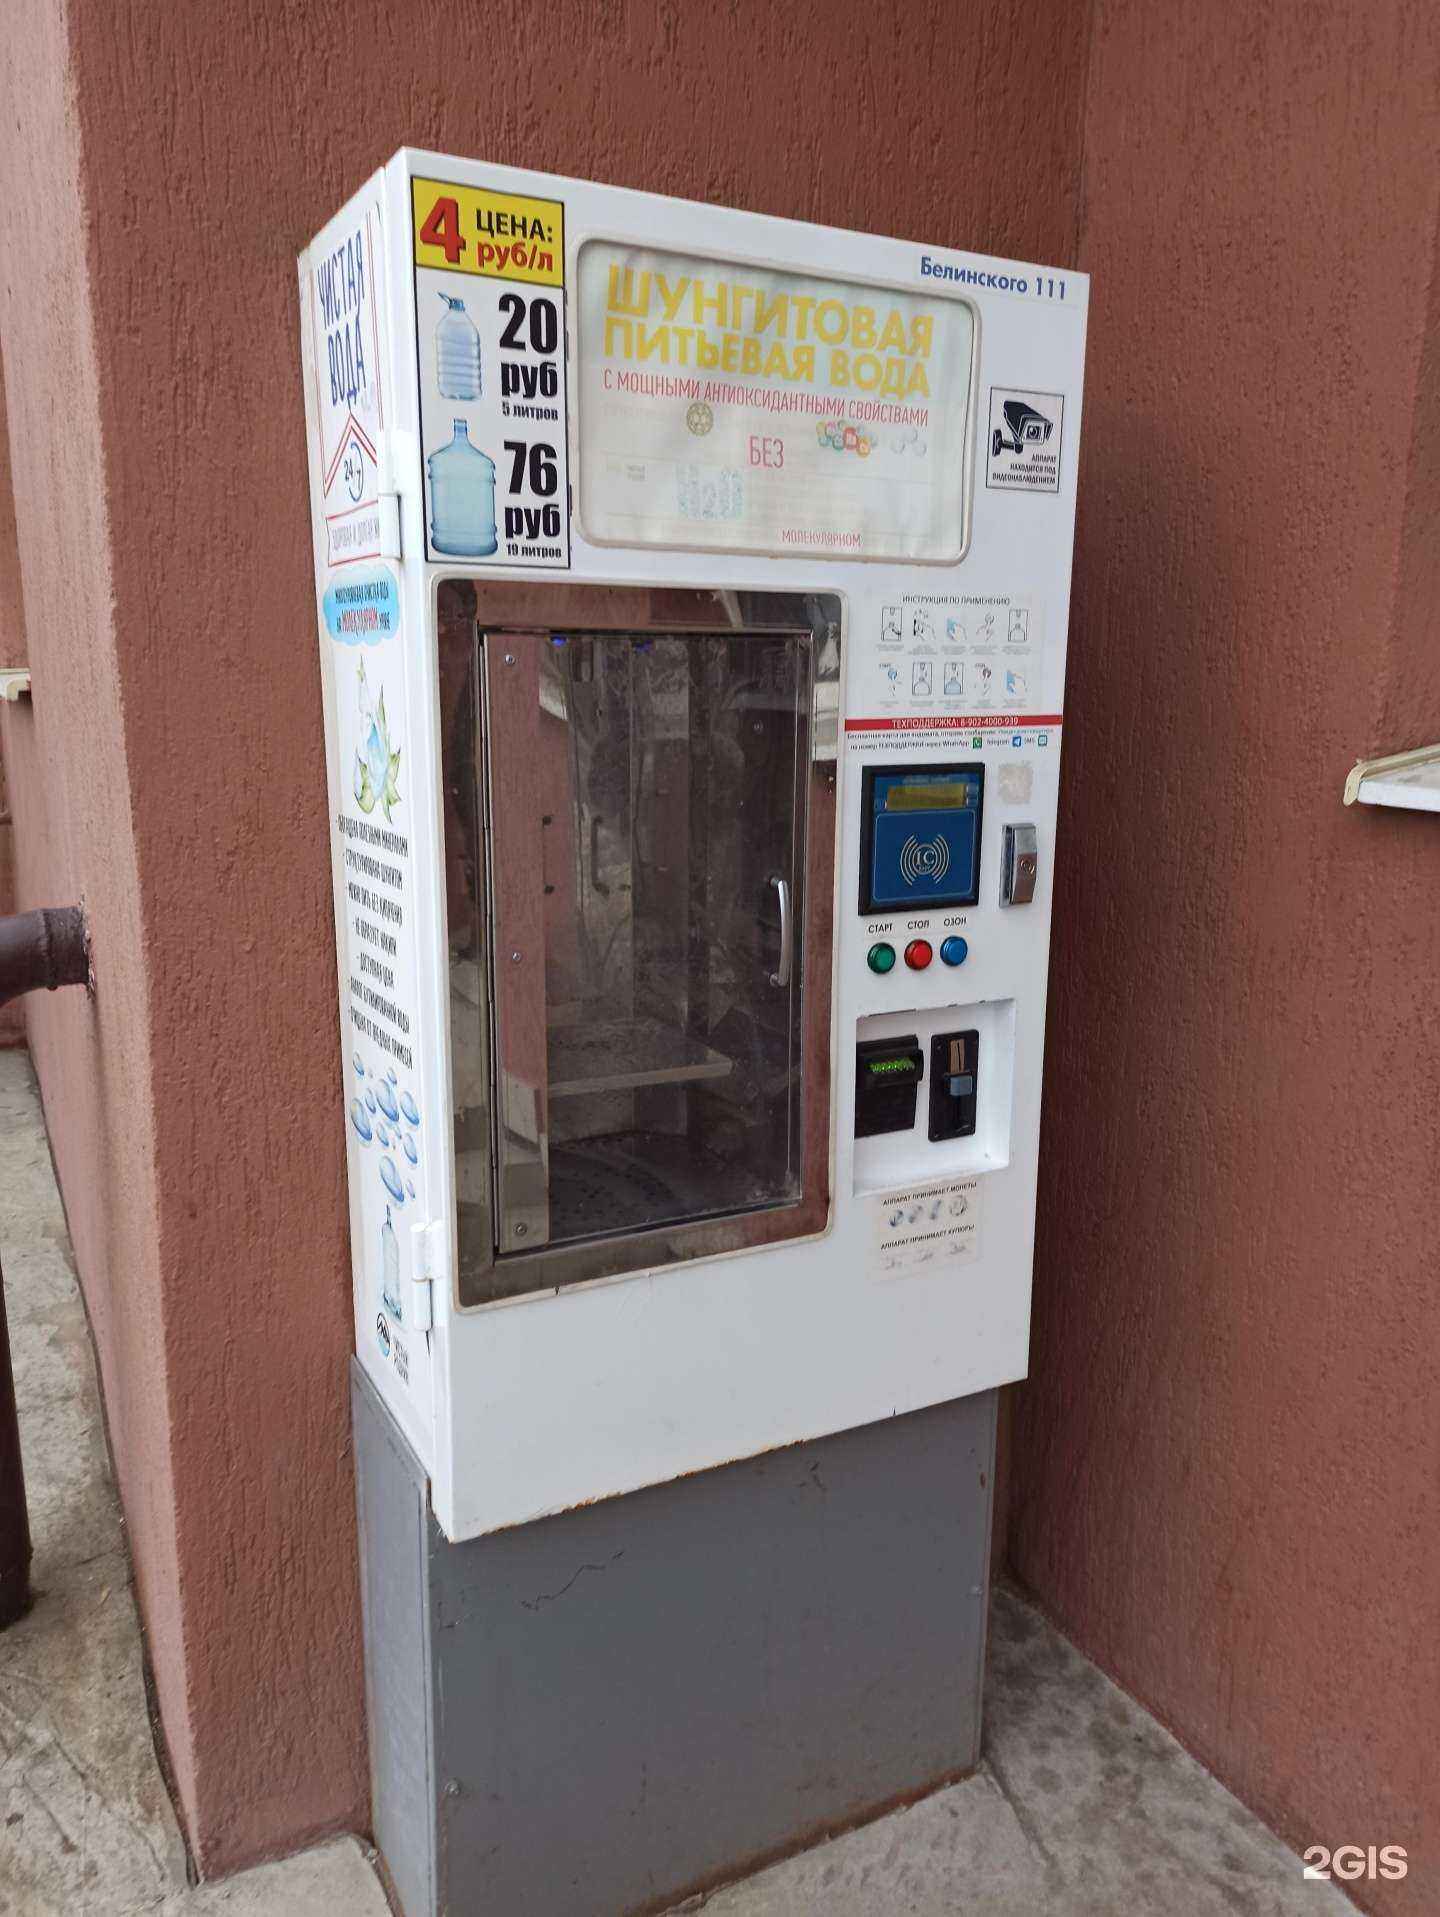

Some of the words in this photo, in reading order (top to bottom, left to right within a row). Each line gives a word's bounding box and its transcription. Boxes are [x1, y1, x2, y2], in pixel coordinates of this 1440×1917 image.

[420, 196, 466, 264] 4
[476, 208, 553, 243] ЦЕНА:
[477, 240, 553, 272] руб/л
[317, 230, 365, 330] ЧИСТАЯ
[921, 256, 1028, 293] Белинского
[1036, 277, 1066, 300] 111
[499, 293, 558, 354] 20
[607, 262, 935, 360] ШУНГИТОВАЯ
[328, 316, 366, 406] ВОДА
[603, 314, 816, 383] ПИТЬЕВАЯ
[829, 347, 931, 398] ВОДА
[501, 361, 558, 399] руб
[604, 368, 612, 389] С
[617, 371, 700, 400] МОЩНЫМИ
[704, 381, 845, 417] АНТИОКСИДАНТНЫМИ
[848, 400, 928, 427] СВОЙСТВАМИ
[502, 401, 510, 416] 5
[513, 404, 558, 421] литров
[504, 440, 558, 497] 76
[749, 436, 784, 469] БЕЗ
[504, 504, 561, 540] руб
[506, 543, 519, 556] 19
[521, 546, 562, 559] литров
[868, 922, 893, 934] СТАРТ
[907, 919, 930, 930] СТОП
[943, 917, 967, 927] ОЗОН
